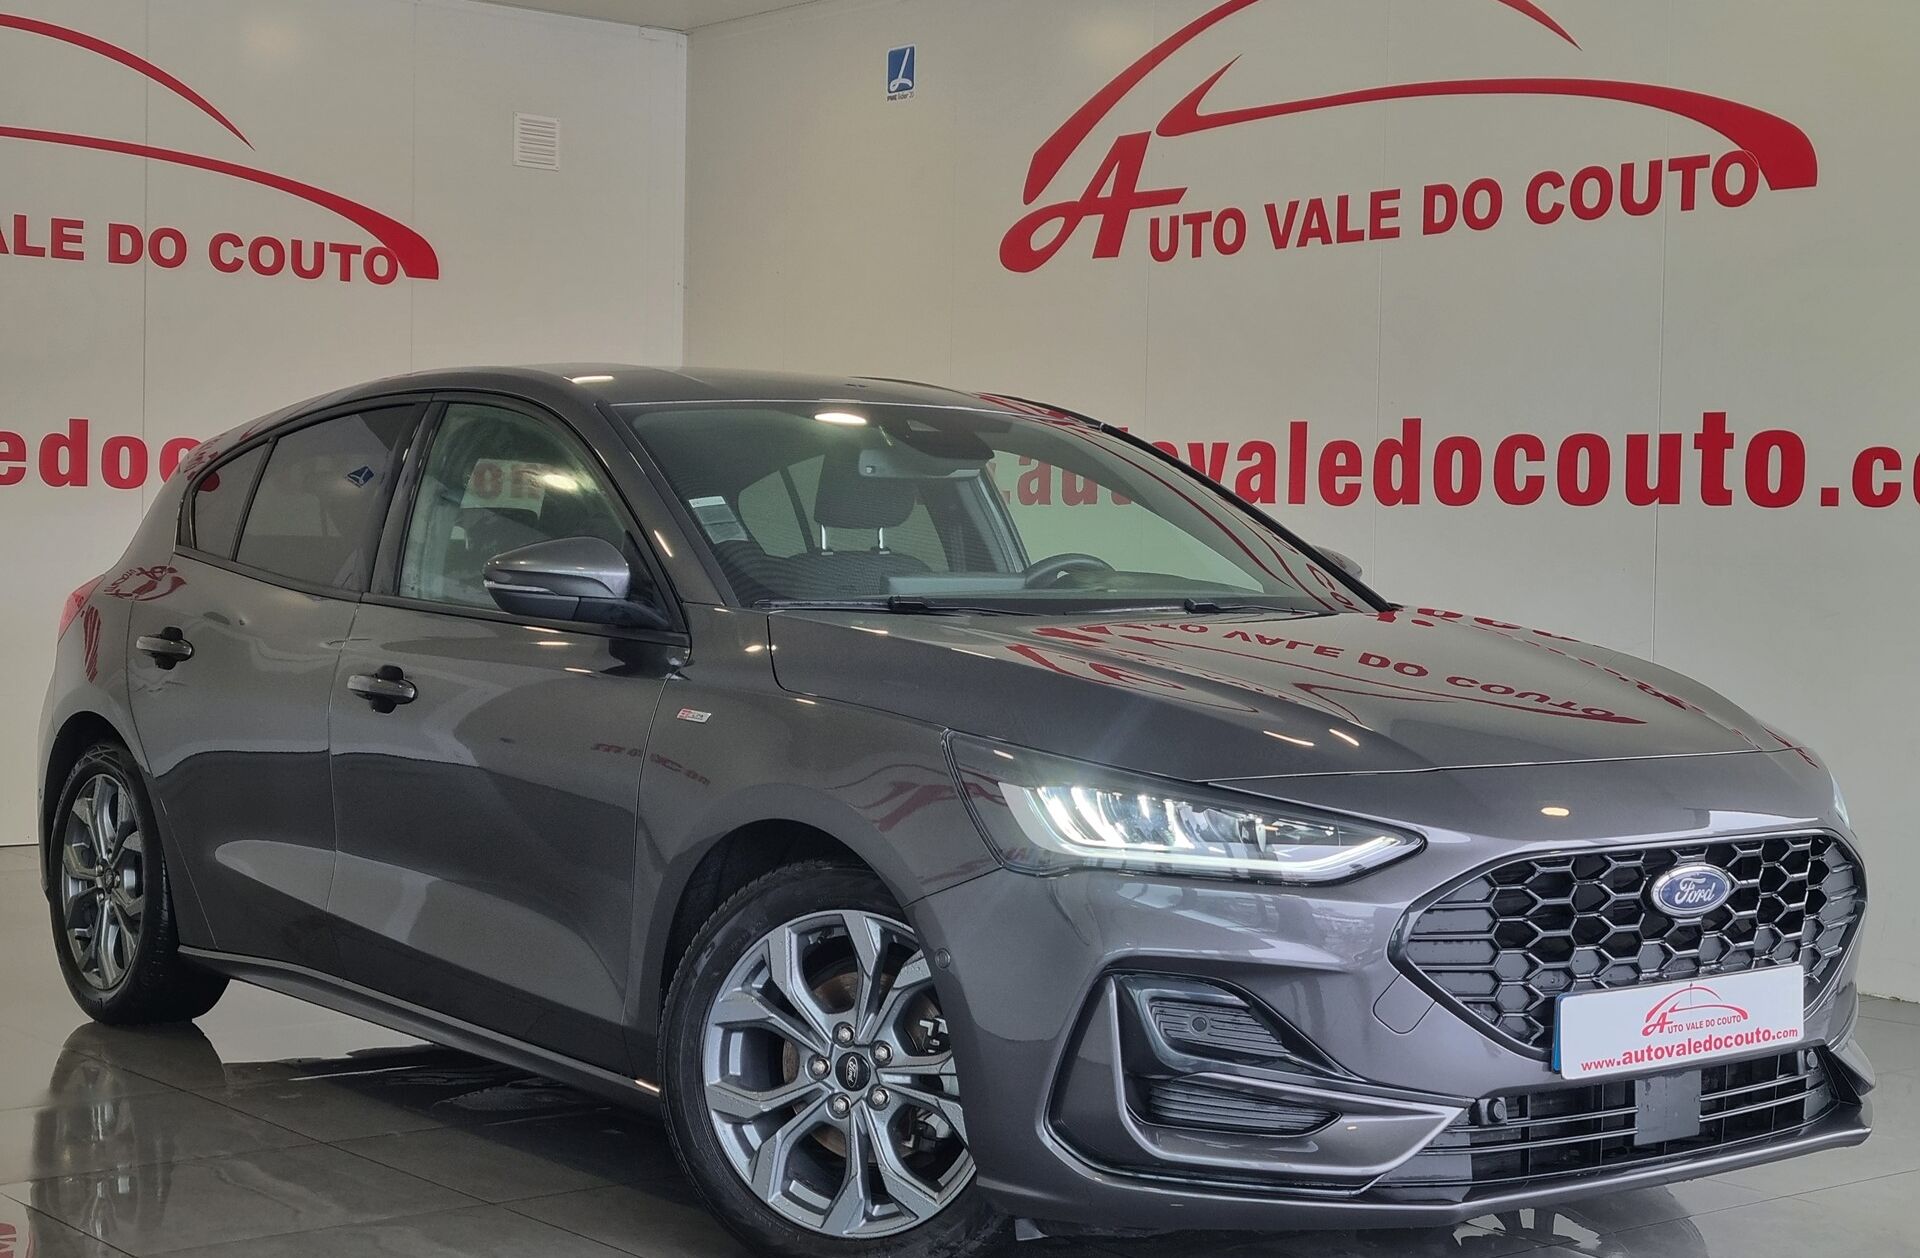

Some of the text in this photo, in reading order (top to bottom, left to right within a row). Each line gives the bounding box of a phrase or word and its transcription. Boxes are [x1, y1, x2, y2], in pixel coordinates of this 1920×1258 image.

[1264, 188, 1402, 251] VALE
[1422, 177, 1504, 237] DO
[1525, 150, 1760, 226] COUTO
[107, 223, 188, 270] DO
[208, 232, 400, 286] COUTO
[1675, 877, 1716, 905] Ford
[1642, 1011, 1742, 1037] AUTO VALE DO COUTO
[1581, 1026, 1798, 1072] www.autovaledocouto.com
